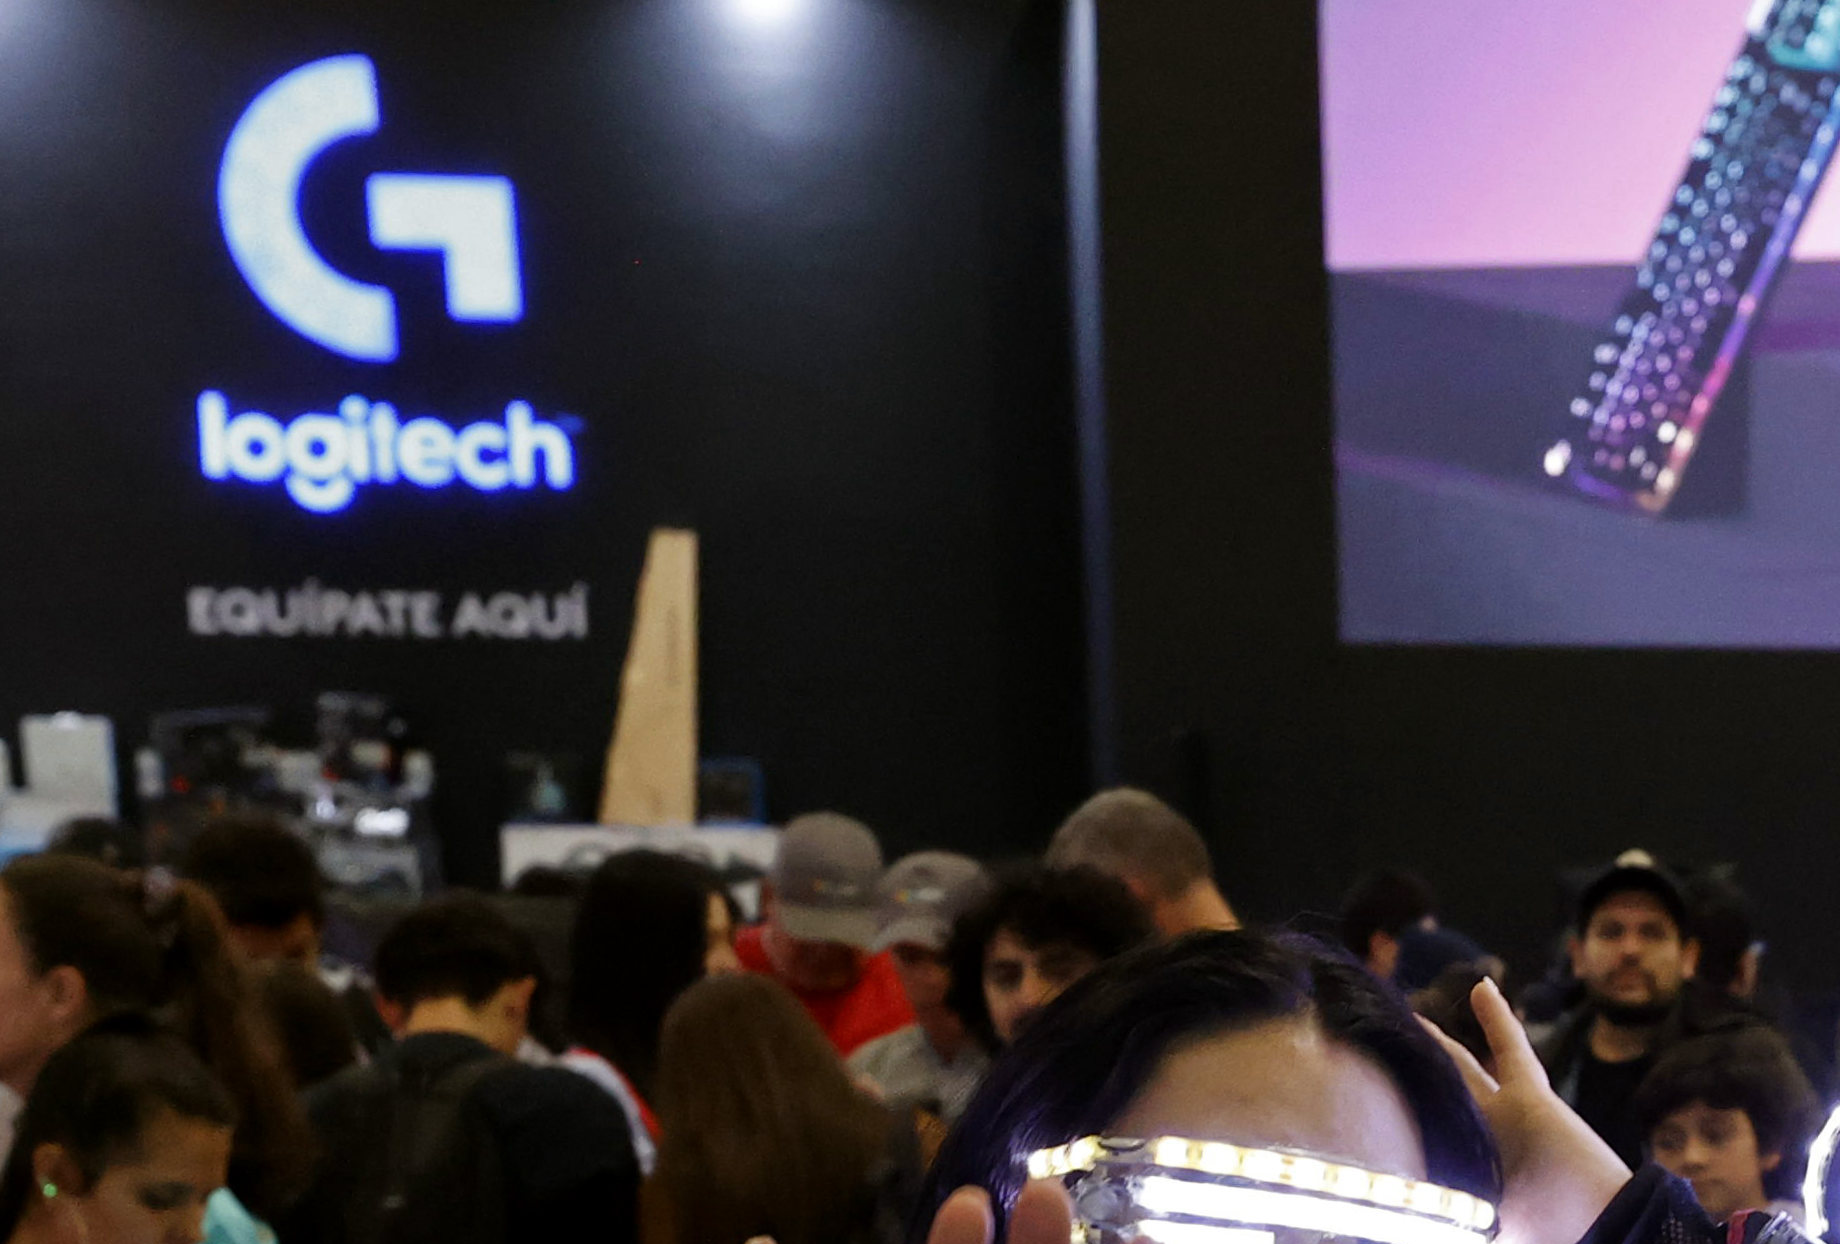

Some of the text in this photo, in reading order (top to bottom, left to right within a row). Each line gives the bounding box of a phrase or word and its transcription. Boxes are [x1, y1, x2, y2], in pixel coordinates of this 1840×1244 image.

[198, 389, 575, 513] logitech
[188, 578, 587, 638] EQUÍPATE AQUÍ
